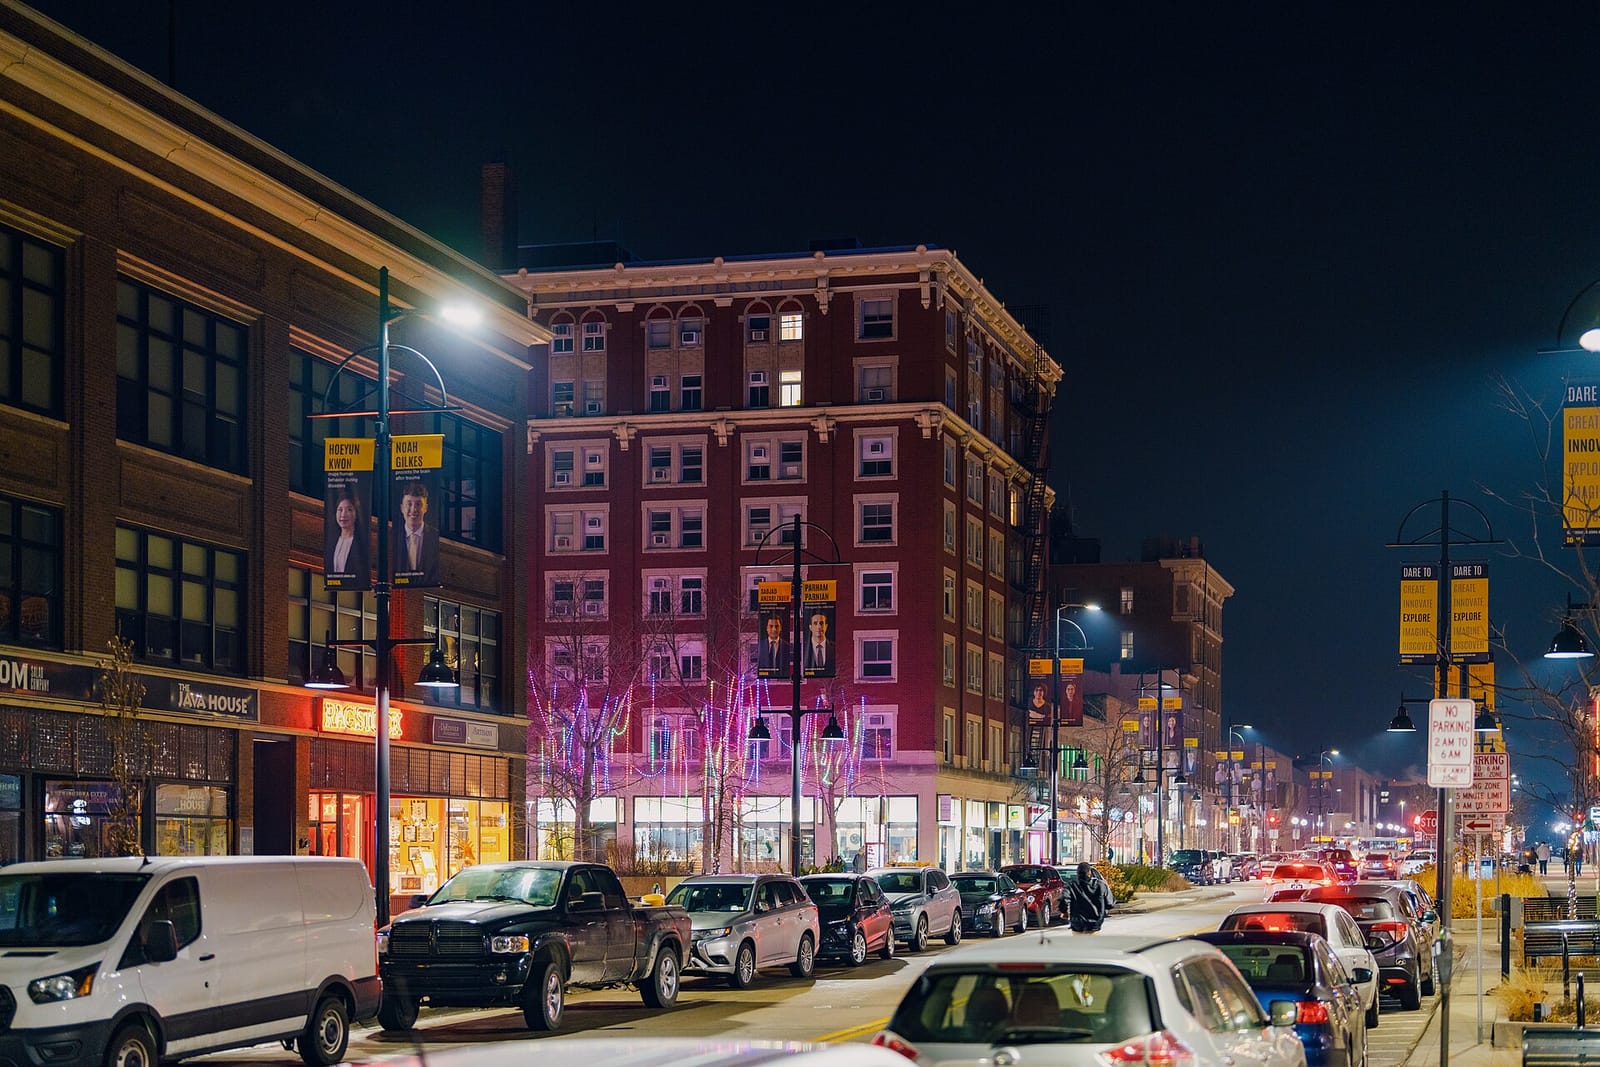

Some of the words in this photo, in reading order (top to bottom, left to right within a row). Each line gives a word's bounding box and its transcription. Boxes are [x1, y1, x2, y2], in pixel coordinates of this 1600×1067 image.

[1568, 386, 1597, 402] DARE
[329, 444, 360, 455] HOEYUN
[396, 442, 418, 454] NOAH
[329, 458, 352, 470] KWON
[396, 456, 423, 468] GILKES
[1403, 568, 1421, 578] DARE
[1424, 567, 1432, 577] TO
[1453, 566, 1472, 576] DARE
[1474, 566, 1482, 576] TO
[804, 584, 828, 592] PARHAM
[1403, 585, 1426, 594] CREATE
[1453, 584, 1476, 592] CREATE
[1403, 600, 1432, 608] INNOVATE
[1453, 598, 1484, 607] INNOVATE
[1403, 613, 1430, 622] EXPLORE
[1453, 612, 1482, 622] EXPLORE
[1403, 627, 1430, 636] IMAGINE
[1453, 626, 1480, 635] IMAGINE
[1403, 641, 1432, 650] DISCOVER
[1453, 640, 1484, 650] DISCOVER
[178, 683, 190, 692] THE
[178, 690, 206, 709] JAVA
[208, 694, 248, 714] HOUSE
[1446, 706, 1458, 718] NO
[325, 703, 402, 736] RAGSTK
[1433, 720, 1470, 732] PARKING
[1434, 738, 1440, 746] 2
[1442, 738, 1454, 746] AM
[1458, 737, 1468, 746] TO
[1440, 750, 1446, 758] 6
[1448, 750, 1461, 758] AM
[1474, 756, 1504, 765] ARKING
[180, 800, 206, 810] HOUSE
[1420, 818, 1437, 828] STO
